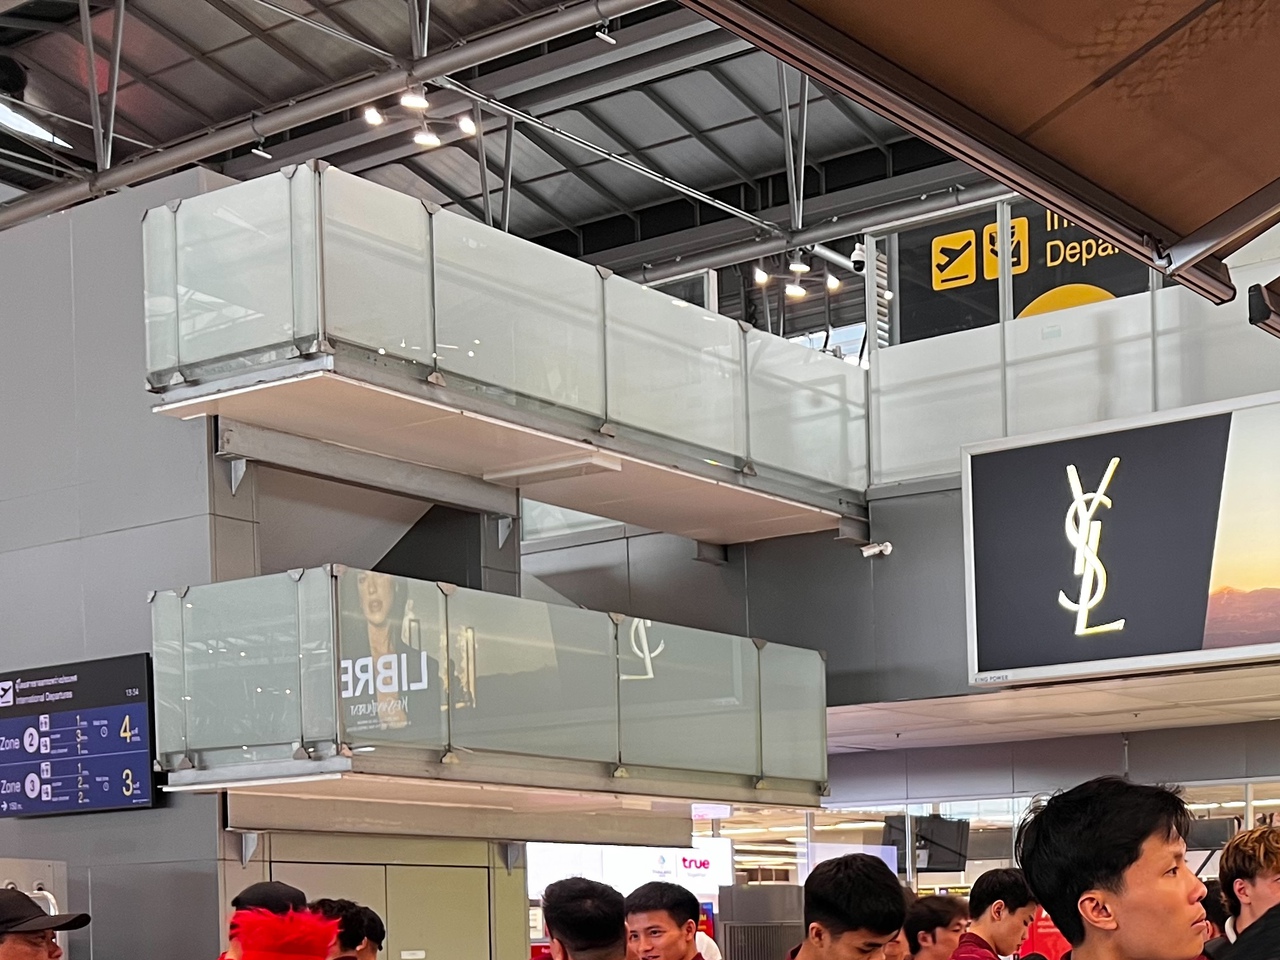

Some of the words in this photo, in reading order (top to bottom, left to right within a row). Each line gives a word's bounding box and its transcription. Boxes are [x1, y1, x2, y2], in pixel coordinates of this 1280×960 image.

[1058, 457, 1126, 636] YSL
[120, 715, 132, 743] 4
[0, 737, 20, 751] Zone
[1, 780, 21, 794] Zone
[122, 769, 133, 796] 3
[682, 856, 710, 870] true
